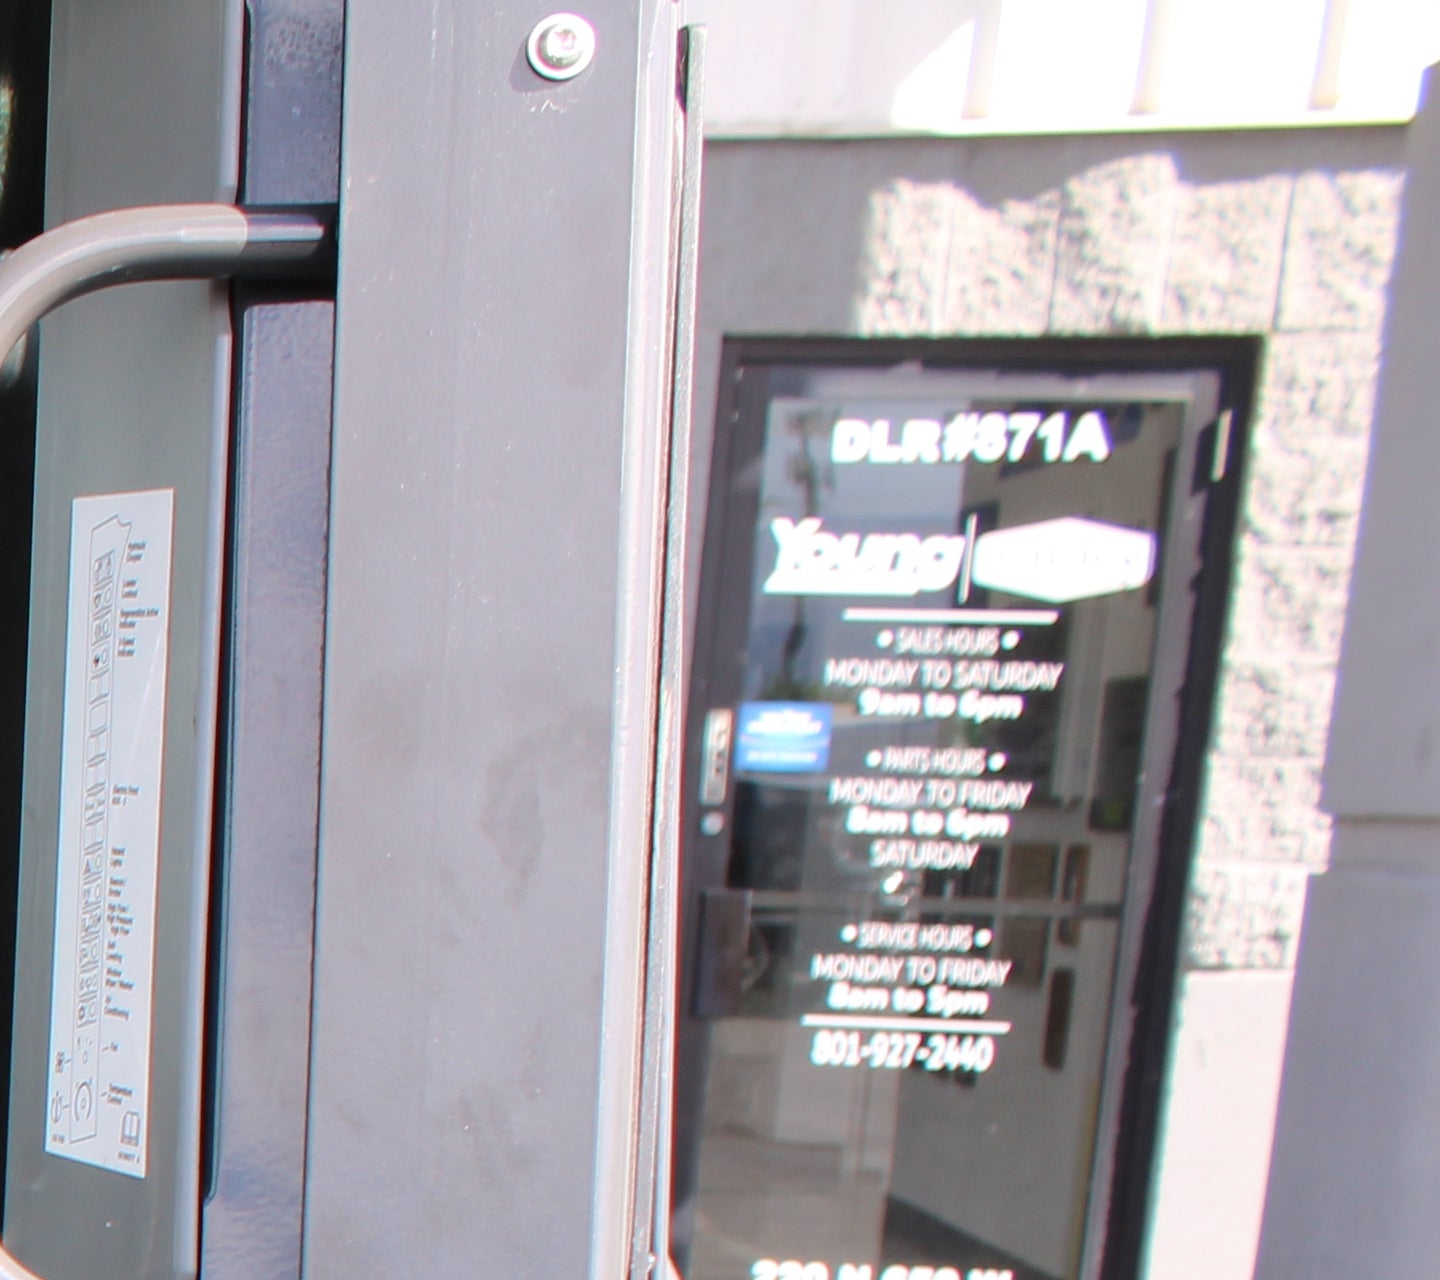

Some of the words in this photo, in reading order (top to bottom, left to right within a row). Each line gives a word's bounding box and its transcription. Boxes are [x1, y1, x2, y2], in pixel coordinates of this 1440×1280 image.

[894, 627, 944, 653] SALES
[945, 627, 1001, 656] HOURS
[823, 659, 919, 687] MONDAY
[921, 660, 951, 689] TO
[953, 660, 1063, 690] SATURDAY
[923, 690, 956, 718] to
[930, 747, 987, 777] HOURS
[828, 777, 923, 805] MONDAY
[925, 779, 956, 808] TO
[958, 779, 1032, 810] FRIDAY
[911, 809, 944, 836] to
[869, 839, 980, 870] SATURDAY
[857, 921, 919, 949] SERVICE
[920, 923, 973, 952] HOURS
[810, 953, 905, 983] MONDAY
[906, 956, 937, 986] TO
[938, 957, 1012, 987] FRIDAY
[891, 986, 925, 1013] to
[810, 1030, 995, 1072] 801-927-2440
